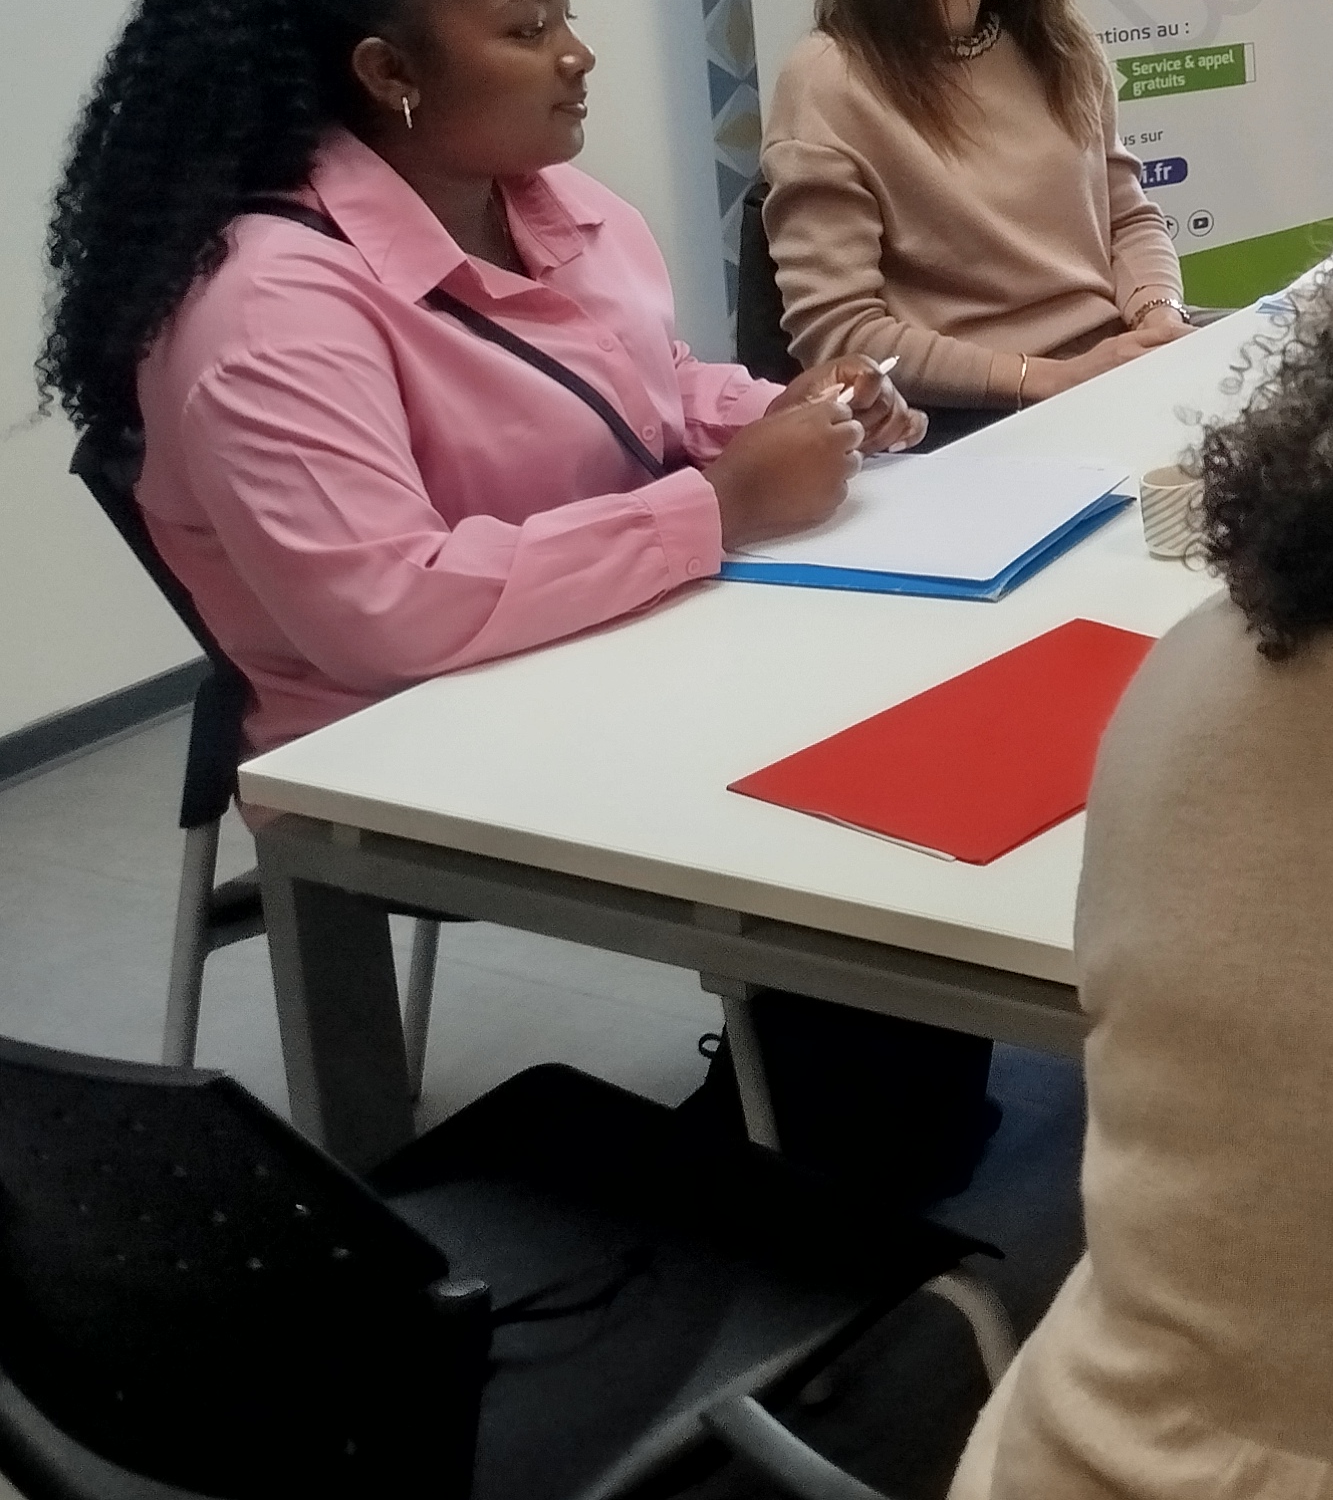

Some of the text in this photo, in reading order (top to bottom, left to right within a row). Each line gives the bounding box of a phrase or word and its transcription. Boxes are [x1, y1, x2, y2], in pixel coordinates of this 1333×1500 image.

[1157, 24, 1178, 38] au
[1132, 49, 1234, 75] Service & appel
[1132, 73, 1185, 96] gratuits
[1141, 130, 1163, 144] sur
